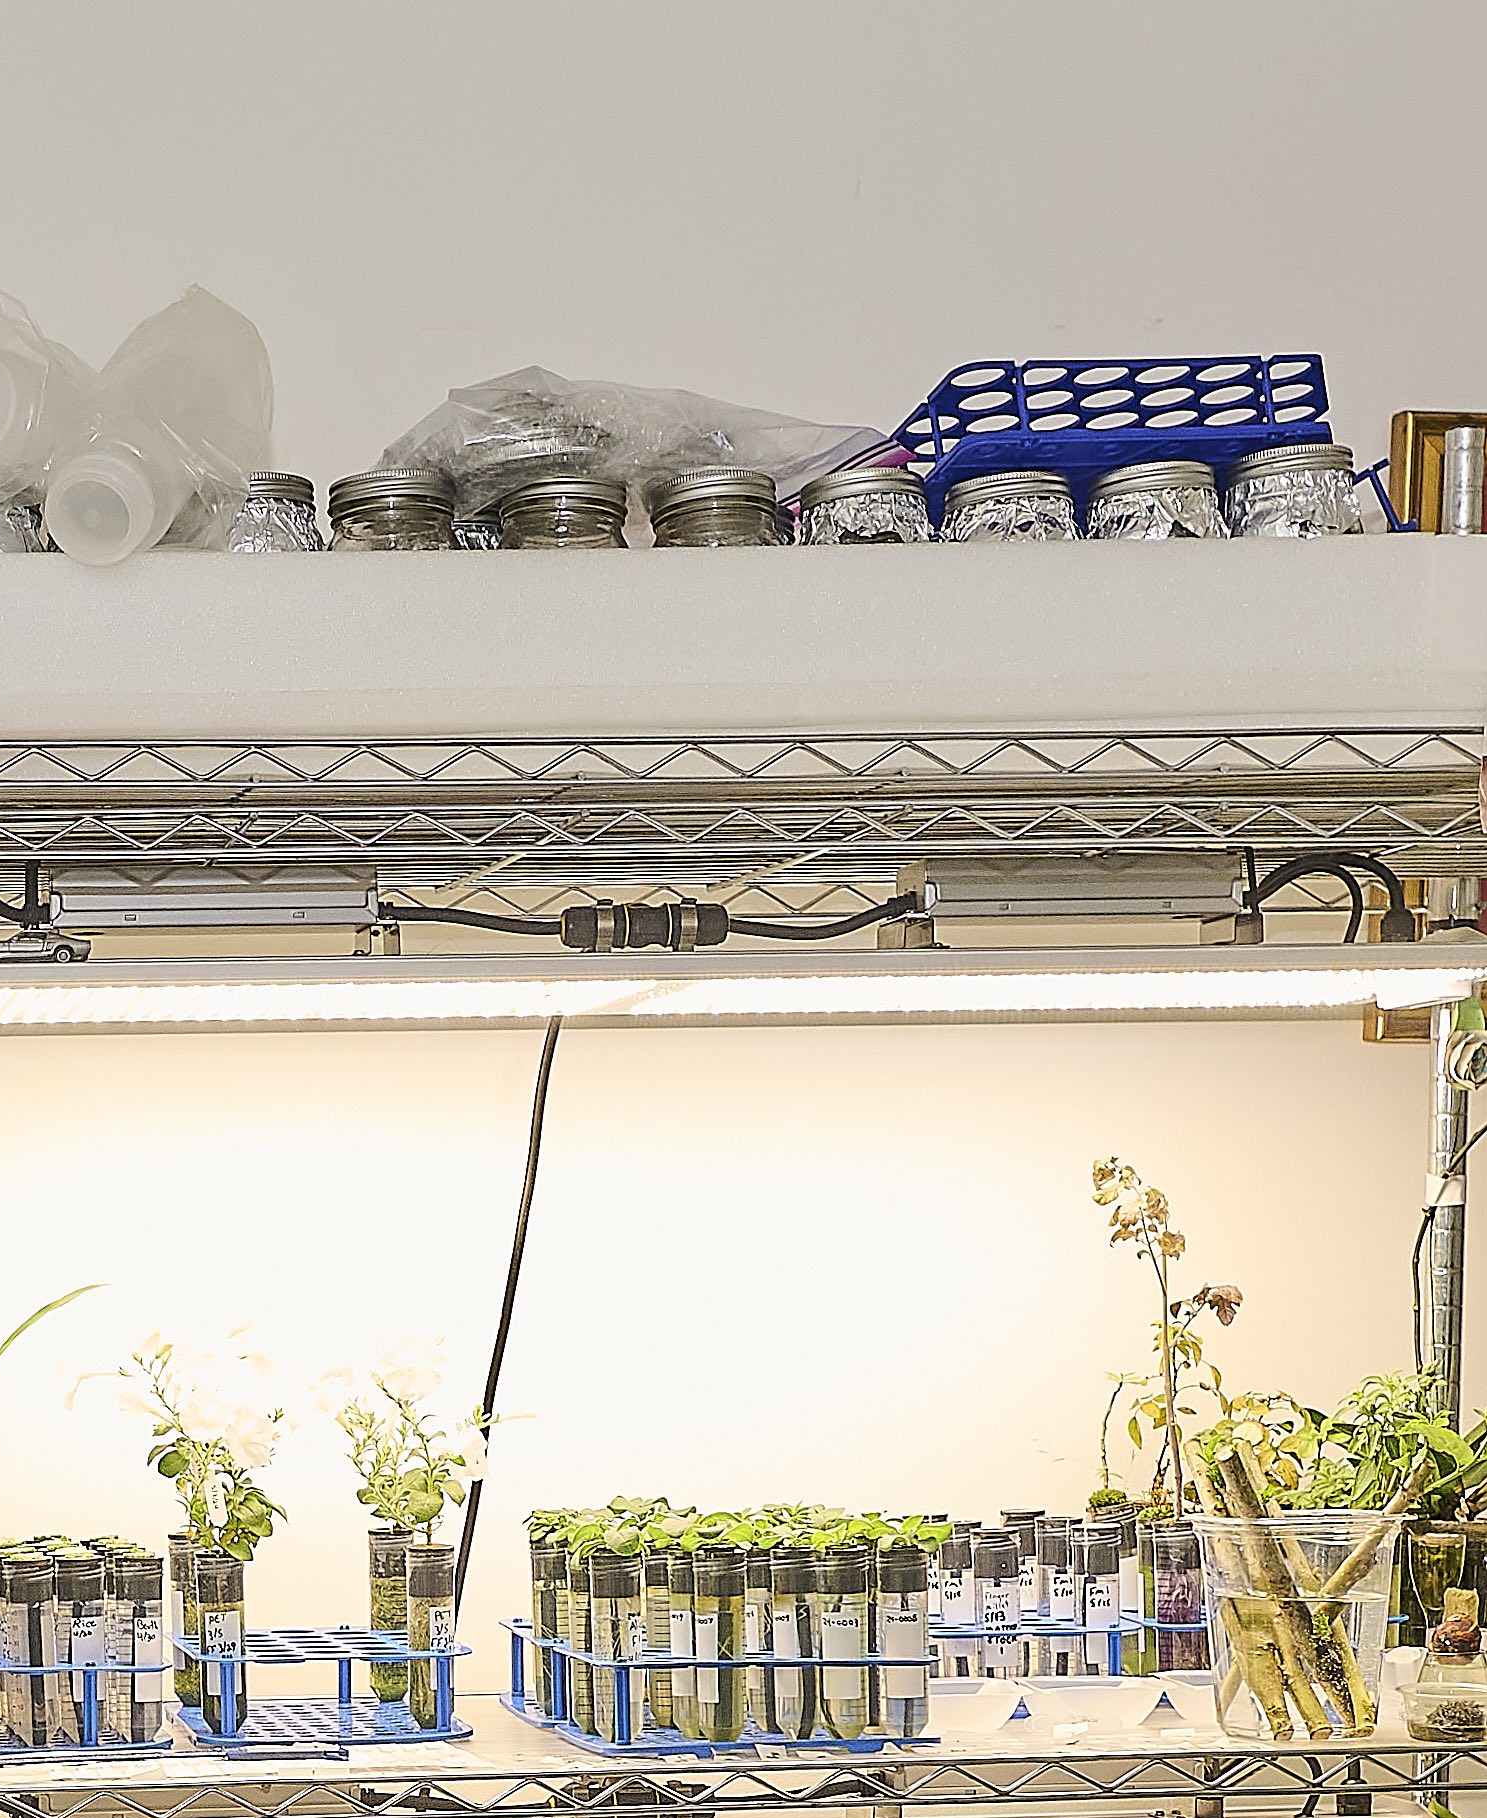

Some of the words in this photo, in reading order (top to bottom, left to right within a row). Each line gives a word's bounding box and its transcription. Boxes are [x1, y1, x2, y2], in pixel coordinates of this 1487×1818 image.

[73, 1618, 97, 1629] Rice
[208, 1613, 228, 1624] PET
[207, 1628, 224, 1641] 3/5
